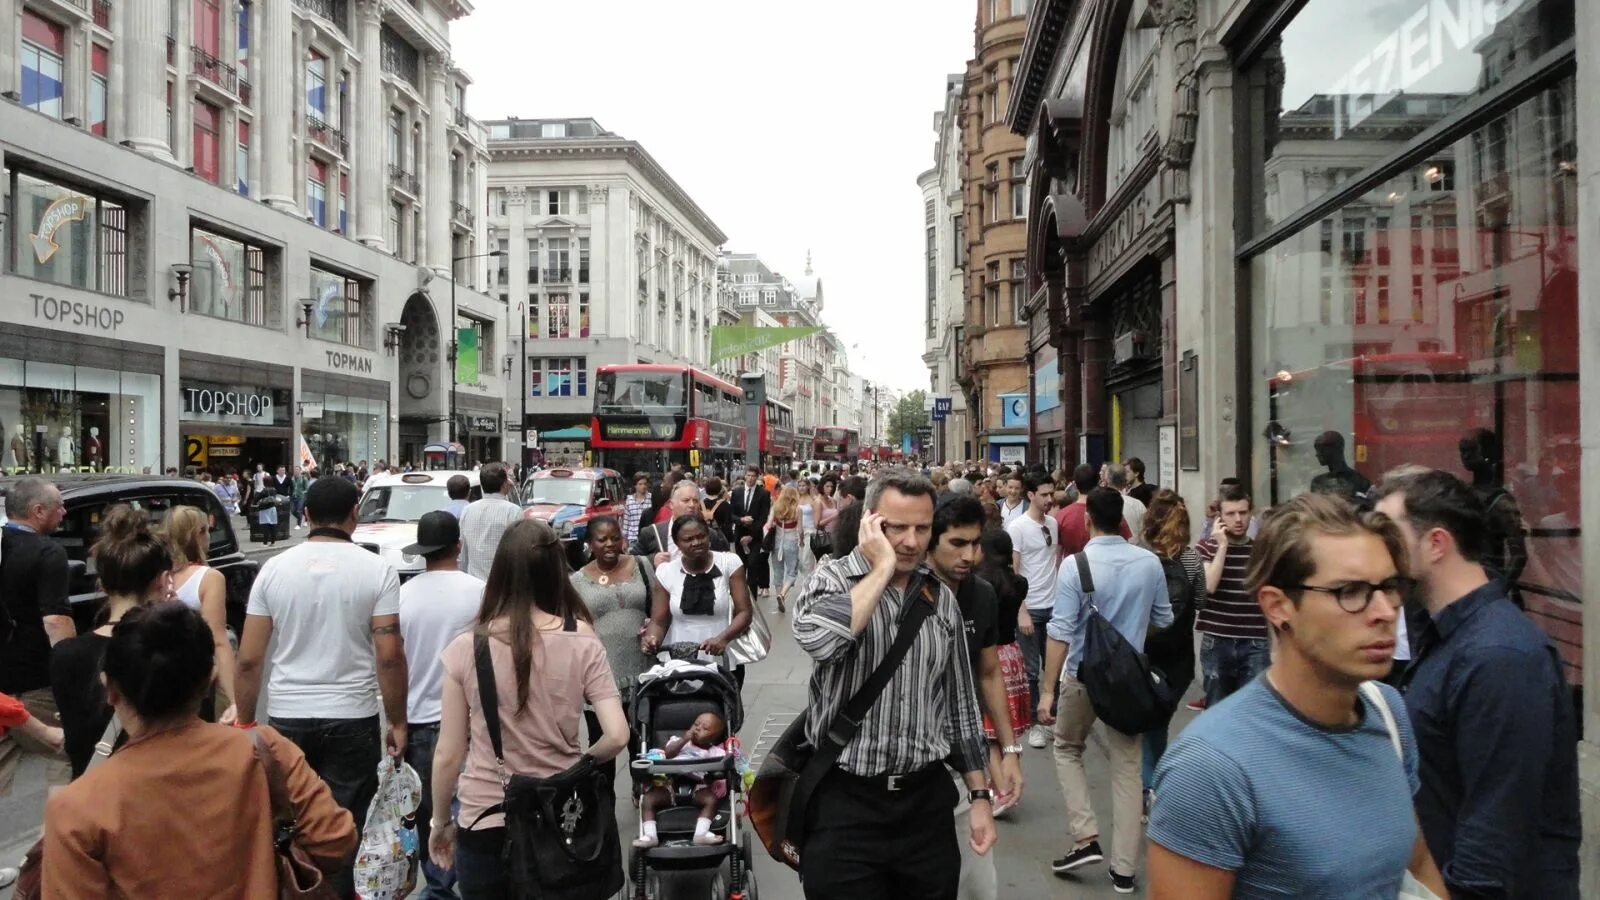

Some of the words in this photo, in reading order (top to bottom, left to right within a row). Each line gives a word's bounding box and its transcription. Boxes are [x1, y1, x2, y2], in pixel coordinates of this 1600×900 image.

[1326, 0, 1526, 140] TEZEN
[40, 202, 78, 240] TOPSHOP
[29, 293, 124, 331] TOPSHOP
[325, 350, 372, 373] TOPMAN
[187, 388, 271, 417] TOPSHOP
[937, 401, 950, 411] GAP
[607, 425, 651, 435] Hammersmith
[661, 425, 672, 436] 10
[187, 438, 203, 465] 2
